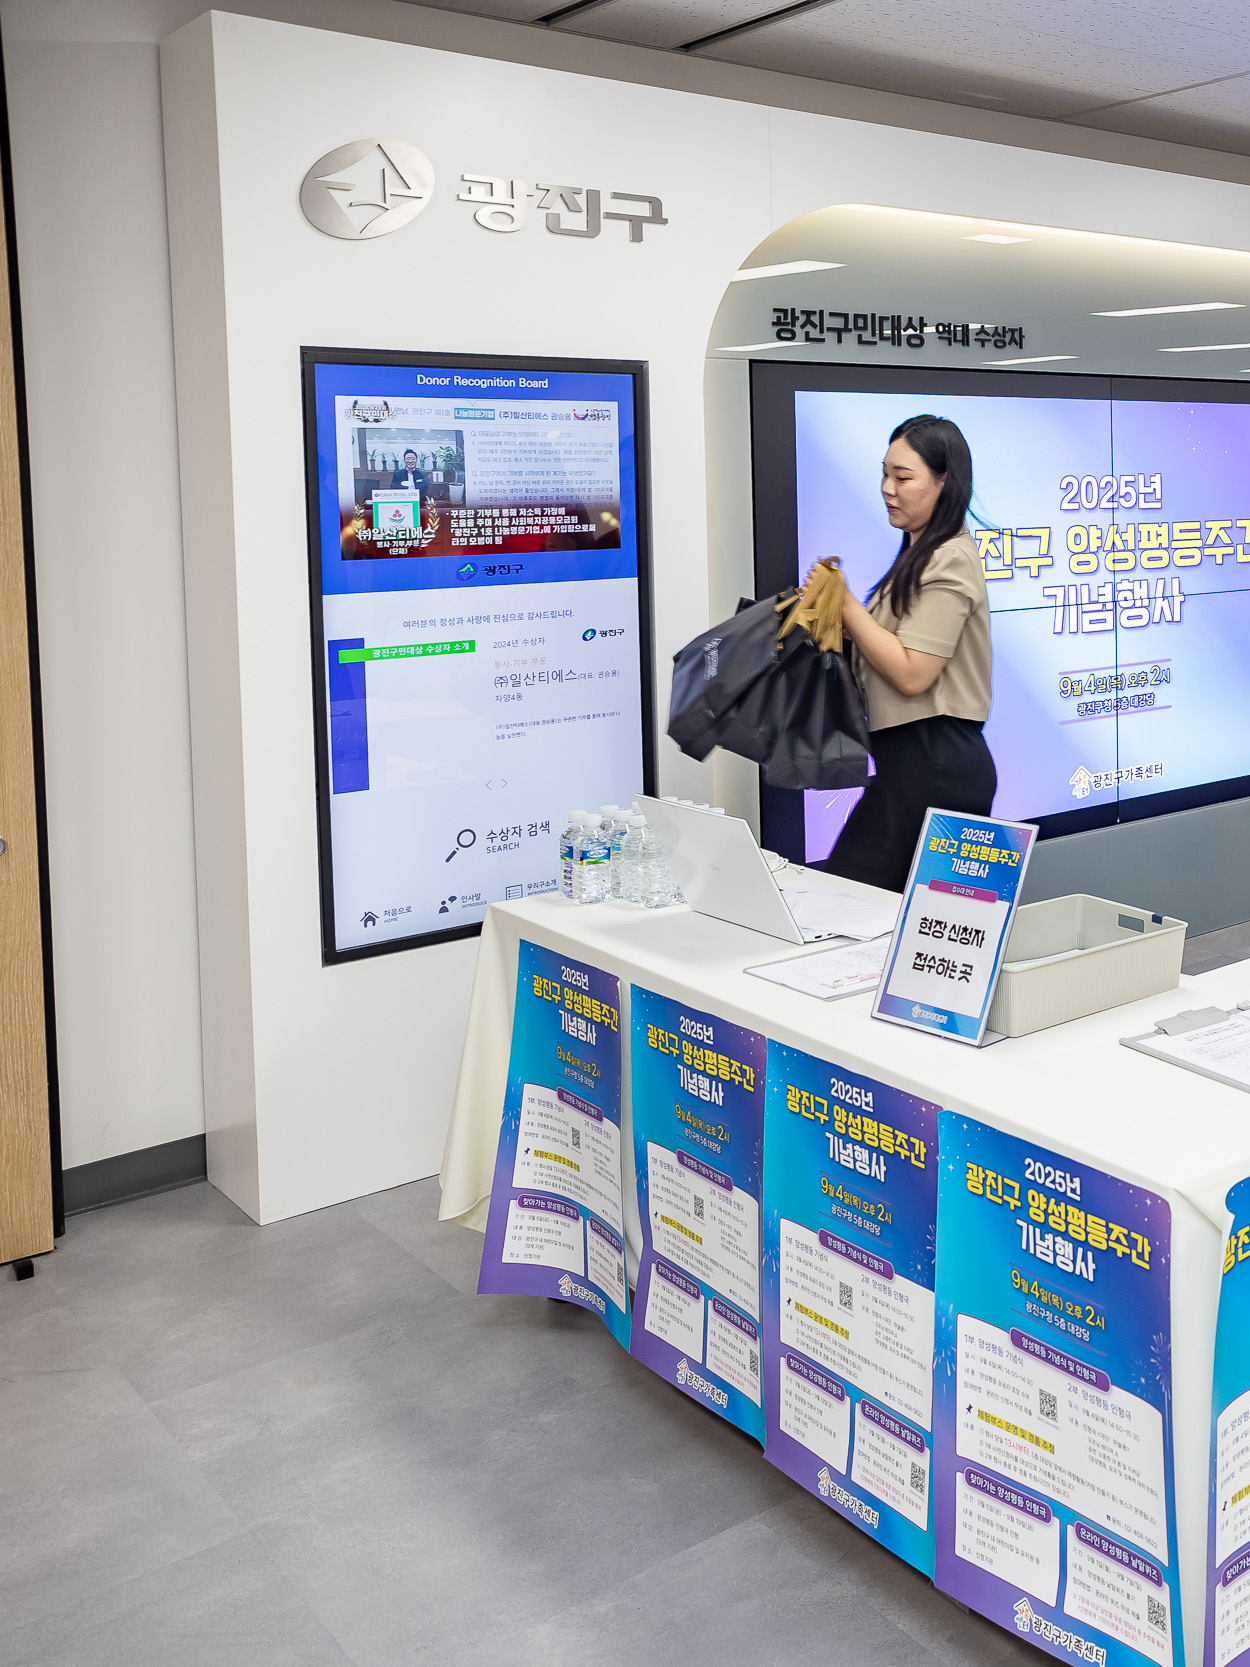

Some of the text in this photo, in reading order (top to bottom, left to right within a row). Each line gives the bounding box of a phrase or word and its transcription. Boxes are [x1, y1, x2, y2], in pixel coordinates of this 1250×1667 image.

[457, 174, 668, 242] 광진구
[771, 307, 1025, 349] 광진구민대상 역대 수상자
[417, 374, 549, 389] Donor Recognition Board
[1059, 473, 1163, 511] 2025년
[975, 526, 1053, 580] 진구
[483, 564, 524, 576] 광진구
[402, 609, 575, 629] 여러분의 정성과 사랑에 진심으로 감사드립니다.
[1043, 577, 1185, 635] 기념행사
[493, 637, 546, 650] 2024년 수상자
[599, 628, 625, 638] 광진구
[372, 642, 470, 659] 광진구민대상 수상자 소개
[531, 656, 547, 666] 부문
[495, 692, 524, 703] 자양4동
[1059, 665, 1171, 698] 9월 4일(목) 오후 2시
[1077, 698, 1112, 716] 광진구청
[1130, 693, 1155, 708] 대강당
[1092, 763, 1164, 788] 광진구가족센터
[486, 820, 551, 843] 수상자 검색
[486, 842, 520, 853] SEARCH
[960, 827, 995, 844] 2025년
[929, 836, 1020, 867] 광진구 양성평등주간
[951, 857, 989, 879] 기념행사
[383, 905, 412, 917] 처음으로
[461, 892, 482, 903] 인사말
[918, 916, 985, 949] 현장 신청자
[561, 965, 589, 991] 2025년
[912, 951, 974, 984] 접수하는 곳
[532, 974, 618, 1032] 광진구 양성평등주간
[558, 1009, 597, 1046] 기념행사
[679, 1015, 714, 1045] 2025년
[647, 1022, 755, 1092] 광진구 양성평등주간
[677, 1063, 724, 1107] 기념행사
[829, 1077, 874, 1112] 2025년
[786, 1083, 926, 1169] 광진구 양성평등주간
[825, 1131, 887, 1183] 기념행사
[1024, 1157, 1081, 1201] 2025년
[965, 1161, 1151, 1270] 광진구 양성평등주간
[1016, 1218, 1096, 1282] 기념행사
[1011, 1269, 1105, 1330] 9월 4일(목) 오후 2시
[1025, 1300, 1090, 1342] 광진구청 5층 대강당
[687, 1370, 728, 1409] 광진구가족센터
[830, 1482, 880, 1529] 광진구가족센터
[1033, 1616, 1106, 1666] 광진구가족센터
